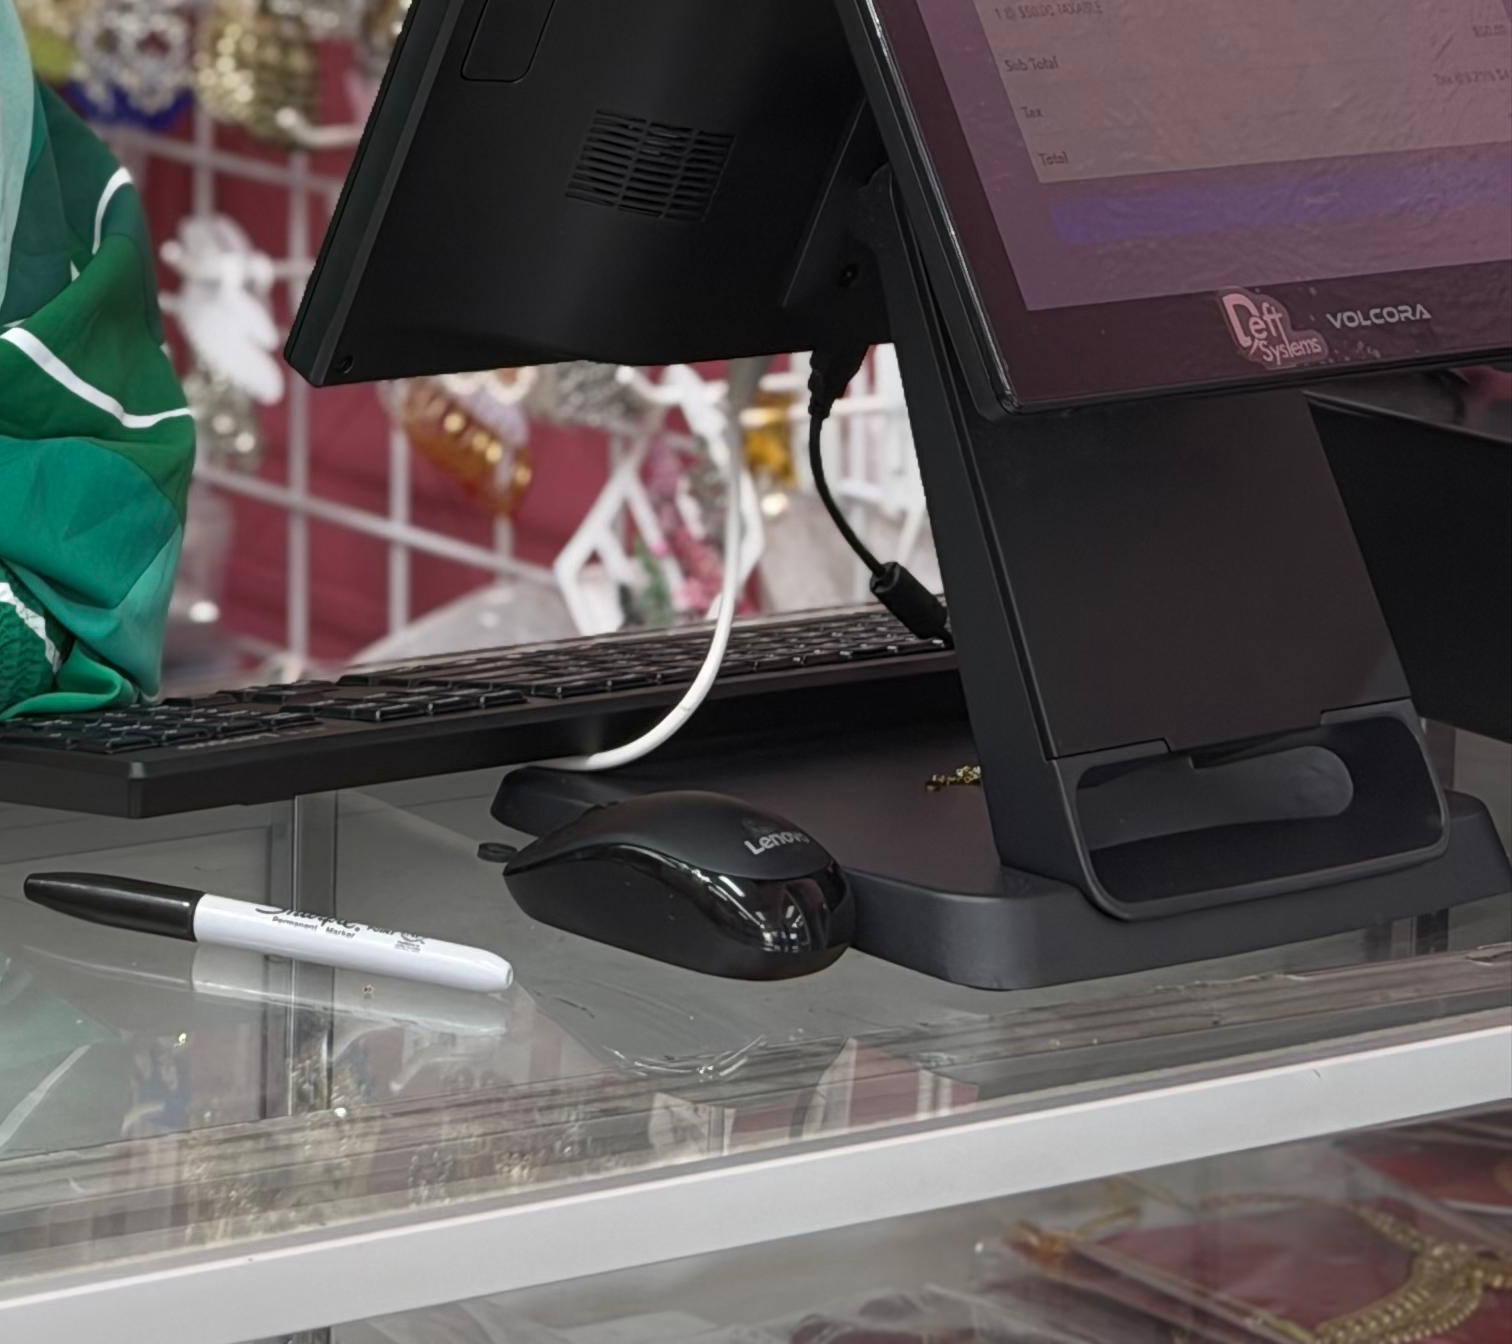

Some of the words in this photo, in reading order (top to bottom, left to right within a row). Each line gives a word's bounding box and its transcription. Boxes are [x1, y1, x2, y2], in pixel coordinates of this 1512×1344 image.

[1004, 58, 1029, 73] Sub
[1029, 55, 1059, 71] Total
[1020, 105, 1045, 119] Tax
[1038, 151, 1070, 166] Total
[1326, 303, 1432, 329] VOLCORA
